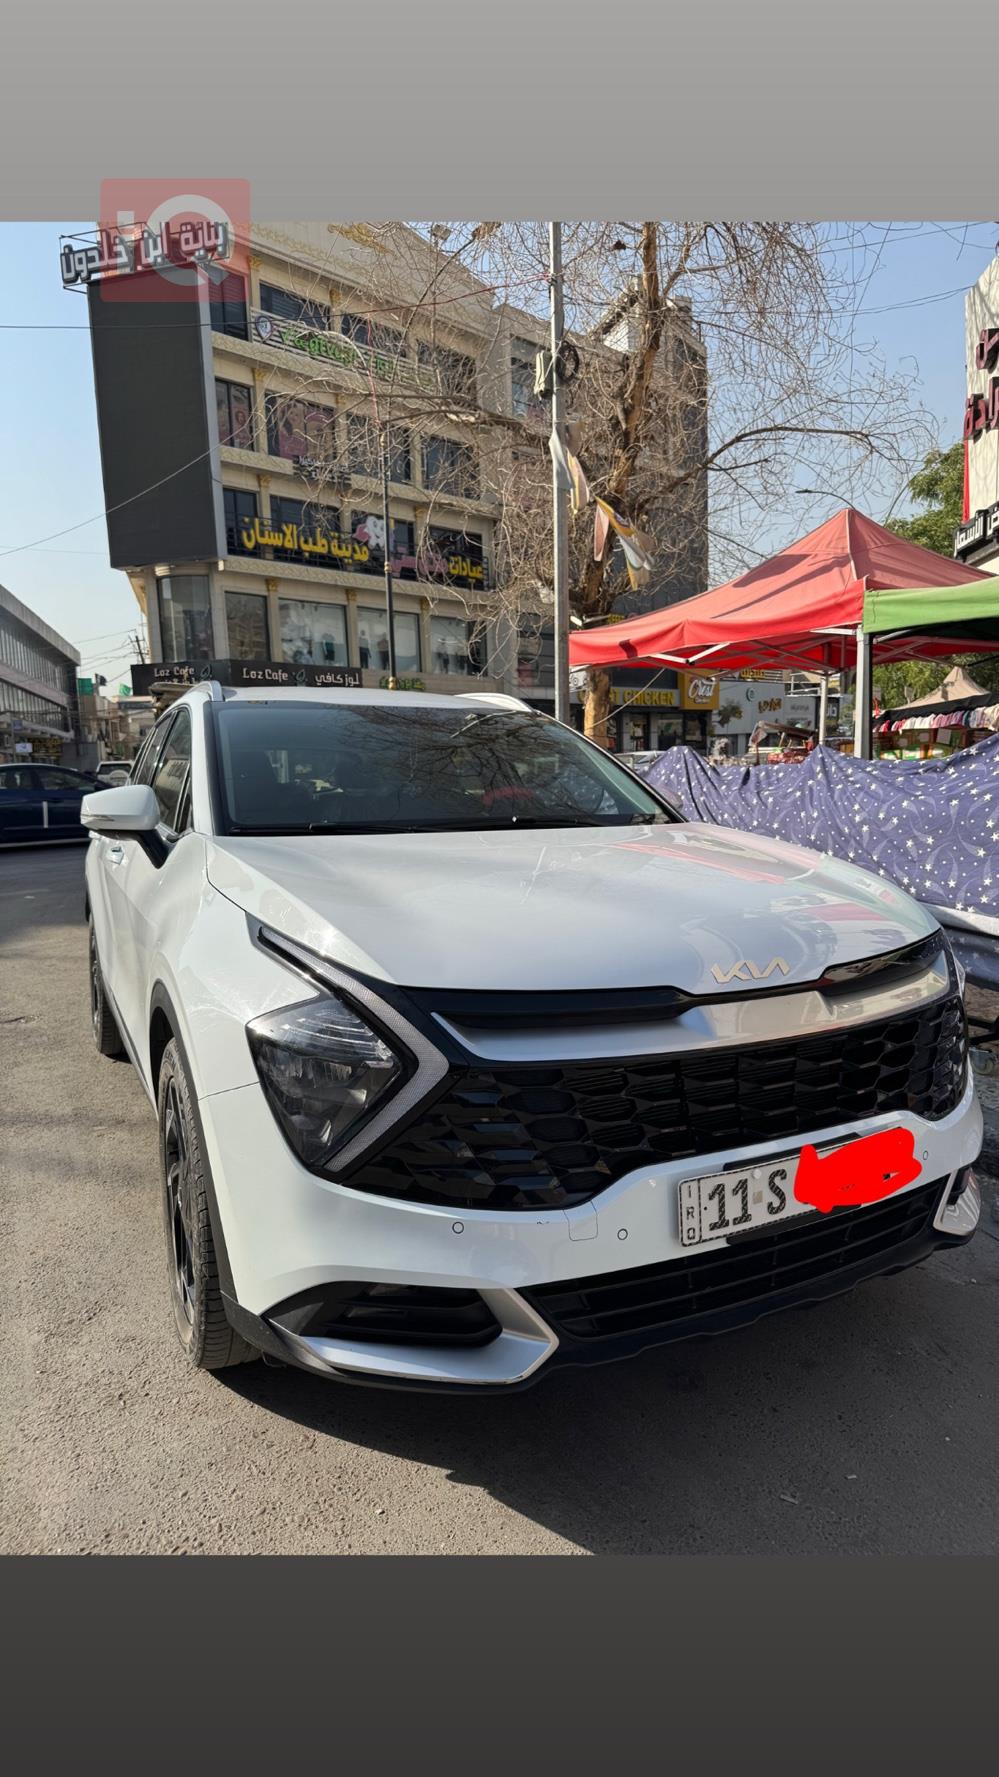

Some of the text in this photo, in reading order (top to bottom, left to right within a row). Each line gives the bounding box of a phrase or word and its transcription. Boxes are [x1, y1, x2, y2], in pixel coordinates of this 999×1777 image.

[299, 527, 329, 557] طب
[173, 665, 195, 676] Cafe
[242, 668, 289, 682] Loz Cafe
[315, 672, 360, 686] لوز كافي
[623, 689, 675, 706] CHICKEN
[711, 956, 790, 984] KIA
[708, 1168, 788, 1231] 11 S
